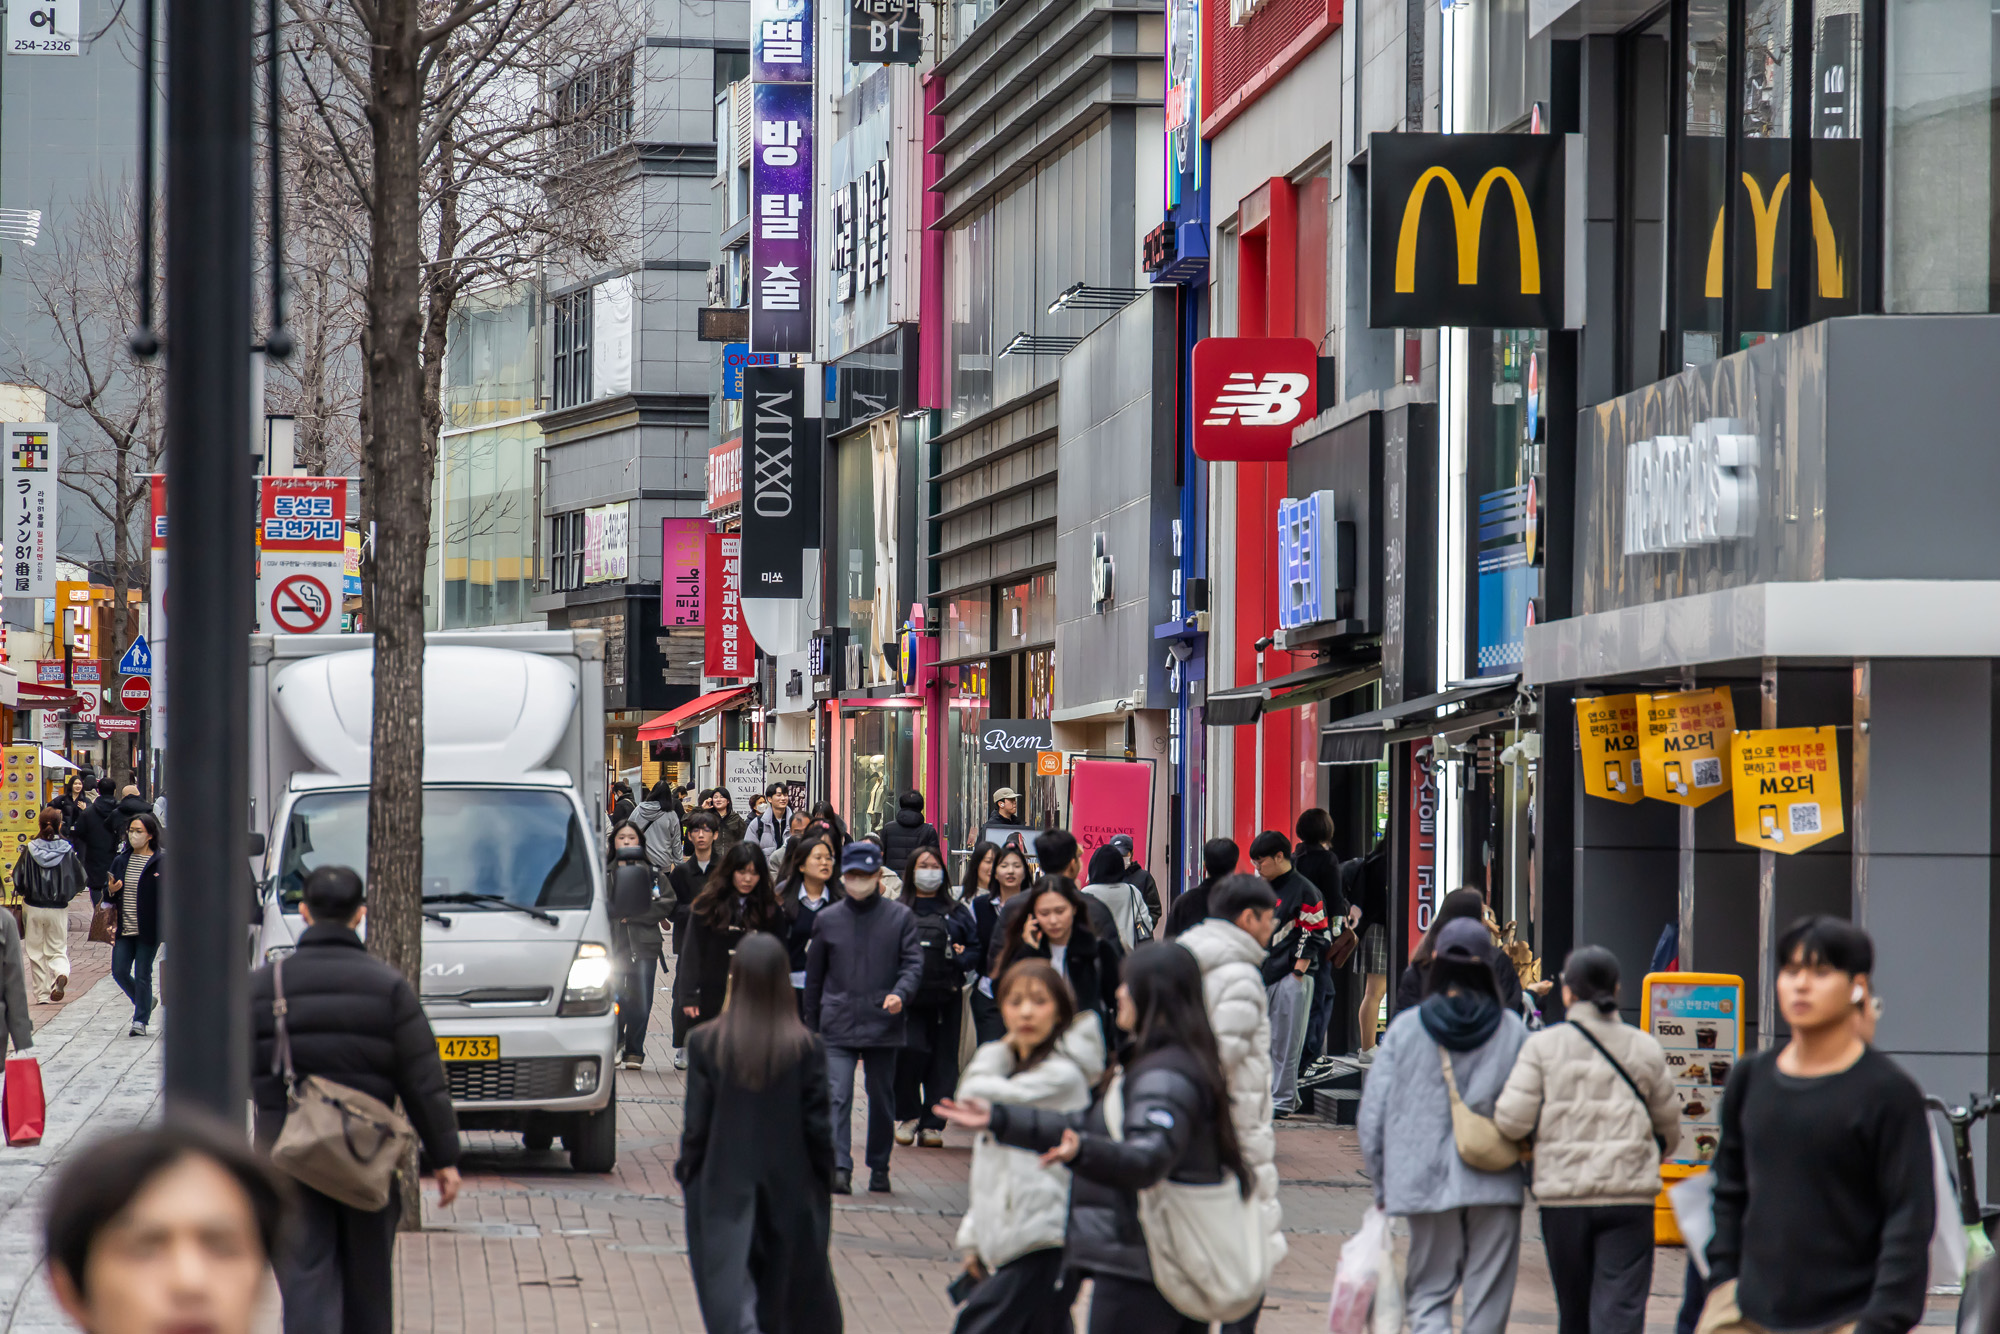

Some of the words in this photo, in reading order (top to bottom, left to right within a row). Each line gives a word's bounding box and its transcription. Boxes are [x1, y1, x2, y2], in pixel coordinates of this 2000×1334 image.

[30, 0, 55, 34] 어
[15, 40, 71, 51] 254-2326
[870, 20, 899, 53] B1
[754, 390, 793, 518] MIXXO
[274, 496, 334, 518] 동성로
[264, 517, 342, 541] 금연거리
[761, 571, 783, 583] 미쏘
[676, 568, 700, 625] 헤어클럽
[722, 558, 739, 622] 세계과자
[722, 624, 739, 671] 할인점
[983, 729, 1053, 752] Roem
[1604, 735, 1640, 753] M오
[1663, 731, 1715, 753] M오더
[1803, 743, 1826, 758] 주문
[737, 785, 758, 793] SALE
[1760, 774, 1815, 796] M오더
[1083, 825, 1135, 834] CLEARANCE
[444, 1040, 491, 1057] 4733
